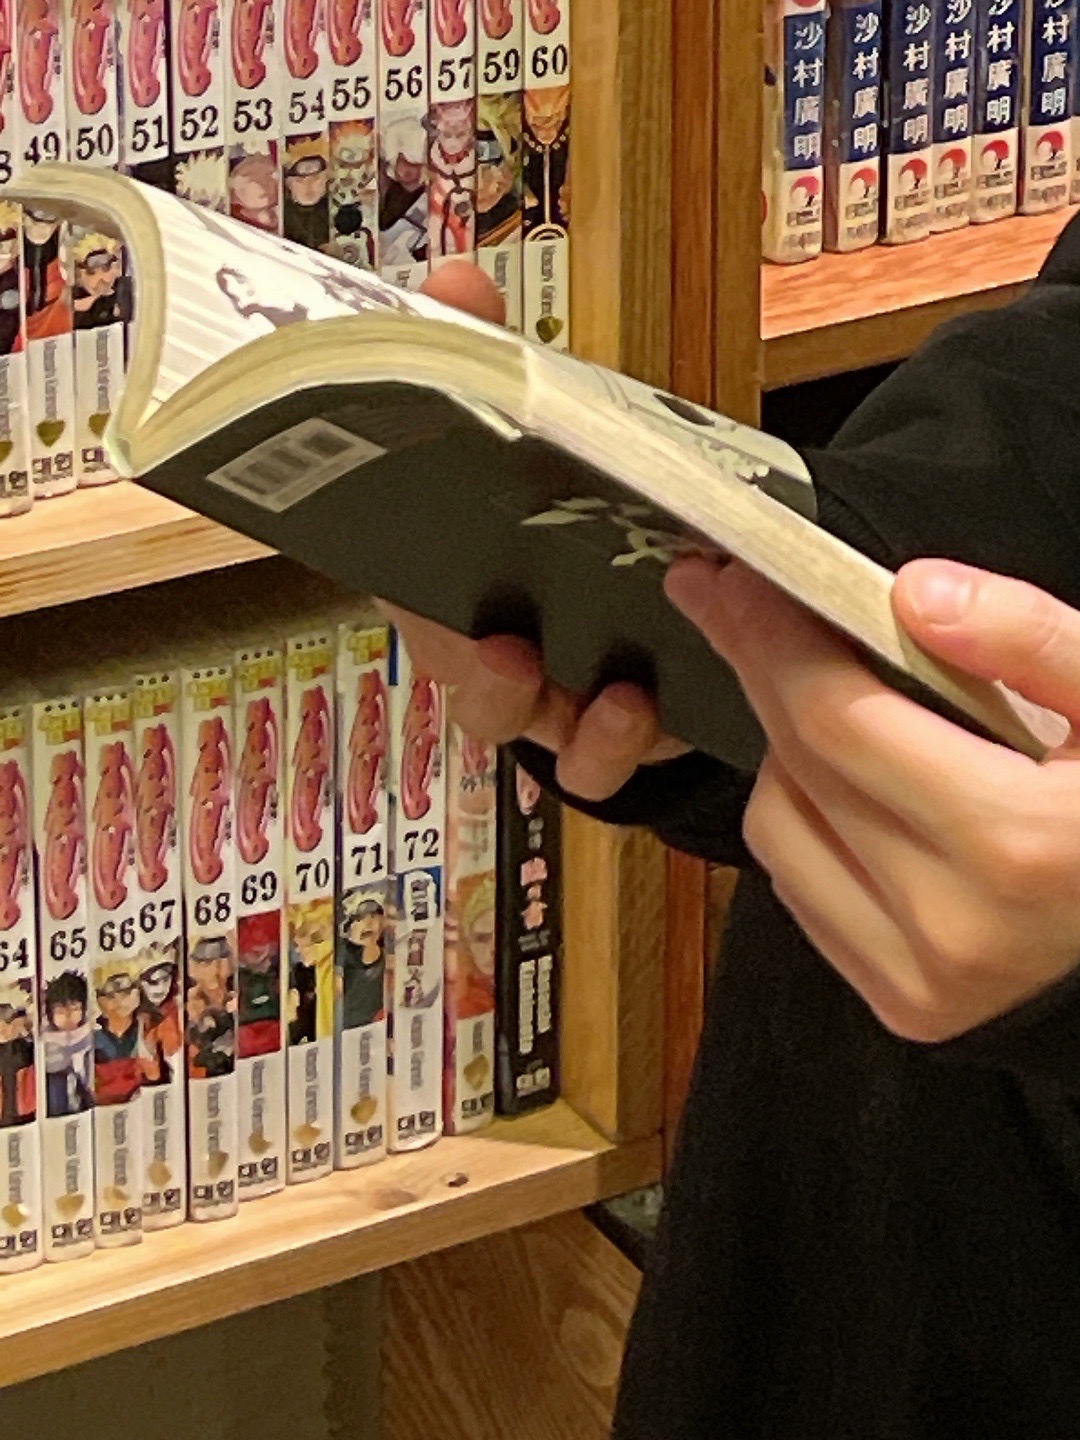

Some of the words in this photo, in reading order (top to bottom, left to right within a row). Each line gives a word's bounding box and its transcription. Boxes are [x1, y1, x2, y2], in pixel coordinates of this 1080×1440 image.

[437, 57, 473, 92] 57
[483, 48, 520, 82] 59
[531, 44, 568, 78] 60
[332, 75, 371, 111] 55
[385, 65, 423, 100] 56
[233, 97, 274, 132] 53
[289, 88, 324, 123] 54
[132, 116, 169, 152] 51
[181, 106, 219, 142] 52
[25, 132, 61, 167] 49
[77, 123, 113, 161] 50
[350, 841, 385, 877] 71
[403, 828, 440, 863] 72
[241, 871, 278, 905] 69
[296, 857, 330, 894] 70
[139, 899, 176, 933] 67
[194, 892, 232, 926] 68
[50, 926, 87, 961] 65
[98, 917, 136, 952] 66
